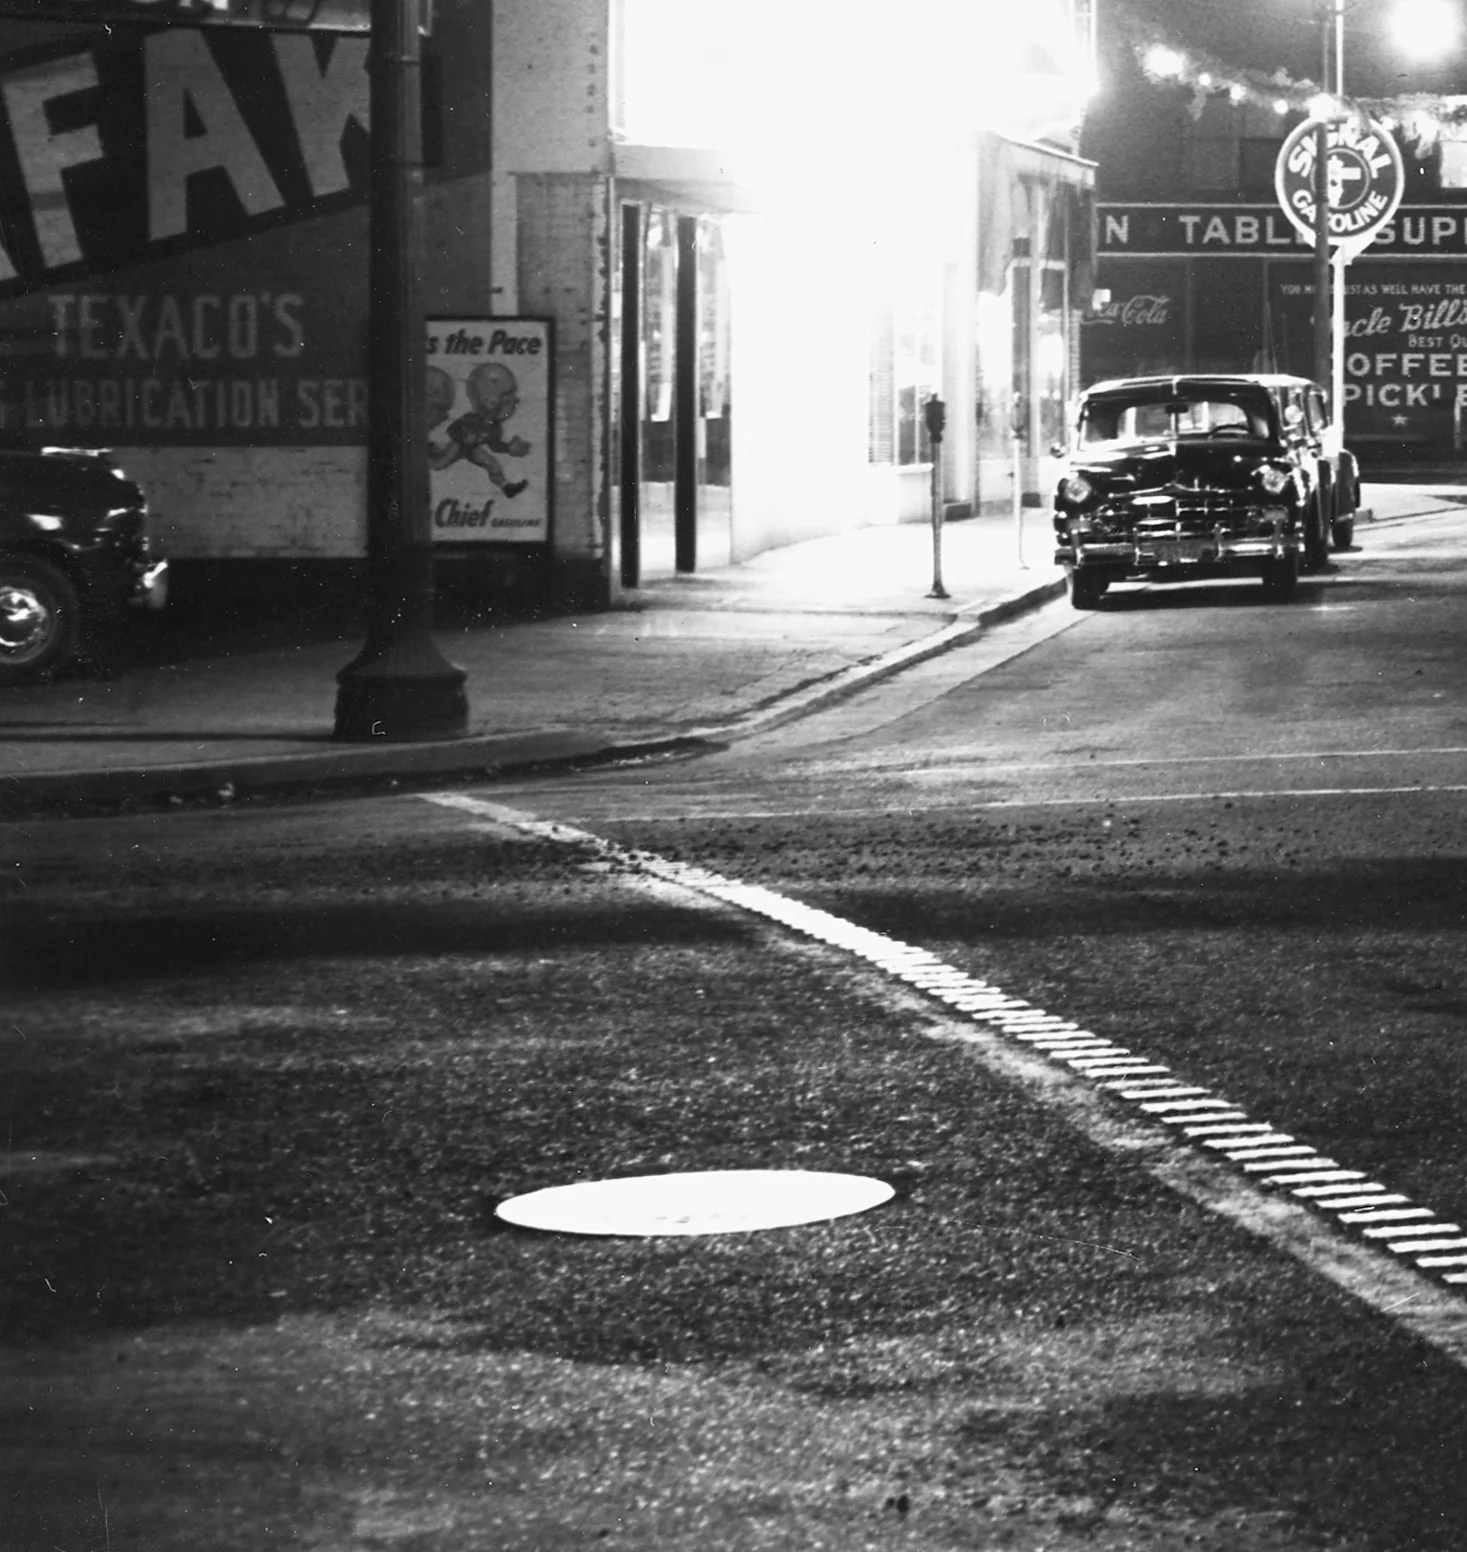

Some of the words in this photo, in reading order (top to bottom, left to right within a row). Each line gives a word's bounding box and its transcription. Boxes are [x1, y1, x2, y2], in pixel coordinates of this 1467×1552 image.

[0, 28, 371, 282] FAK
[1292, 189, 1388, 233] GAOLINE
[1411, 283, 1441, 295] HAVE
[1445, 283, 1466, 295] THE
[47, 292, 306, 360] TEXACO'S
[444, 328, 483, 355] the
[488, 329, 542, 355] Pace
[1408, 335, 1444, 348] BEST
[25, 379, 281, 429] LUBRICATION
[434, 498, 495, 529] Chief
